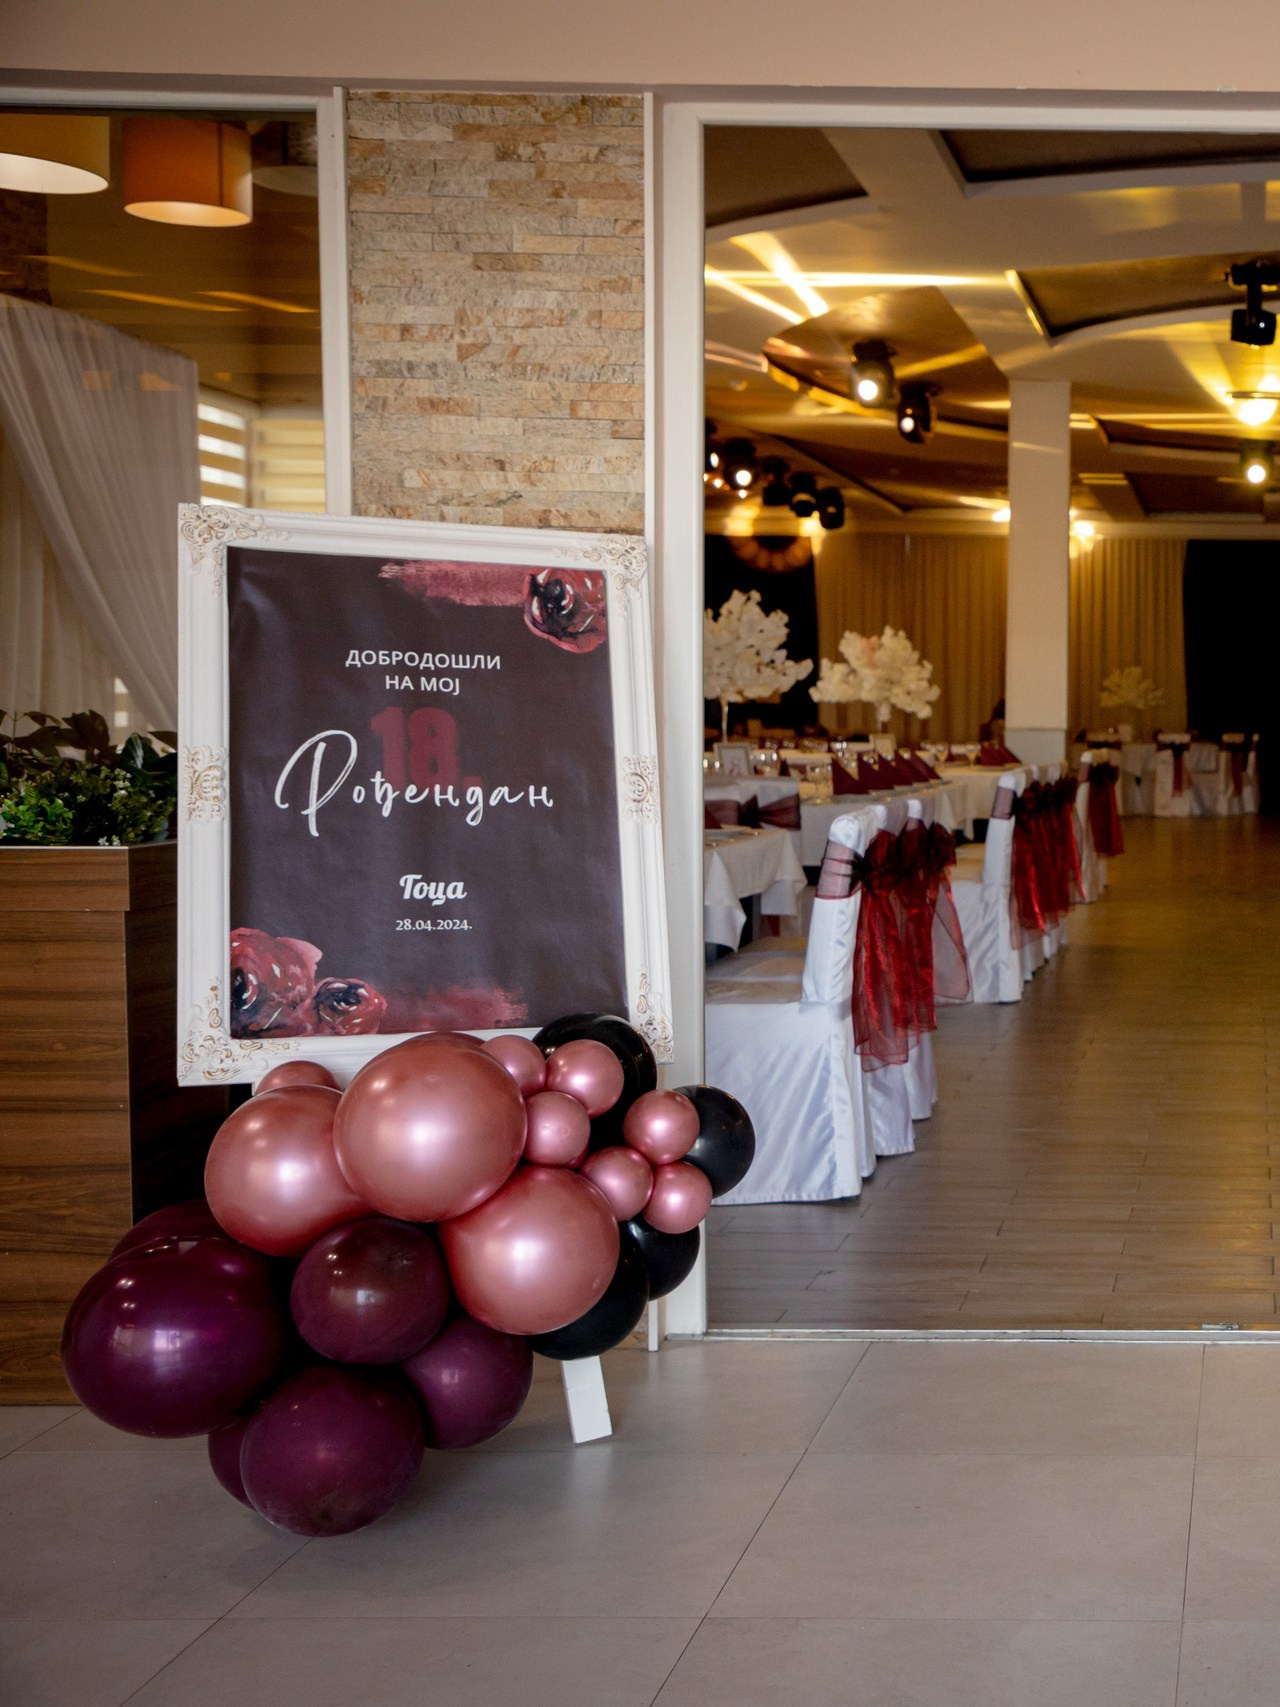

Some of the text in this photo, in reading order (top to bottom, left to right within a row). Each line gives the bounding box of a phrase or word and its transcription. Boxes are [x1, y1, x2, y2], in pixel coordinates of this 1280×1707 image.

[345, 650, 501, 670] ДОБРОДОШЛИ
[385, 675, 460, 695] НА МОЈ
[370, 706, 482, 790] 18.
[274, 729, 553, 837] Рођендан
[399, 874, 467, 906] Тоца
[395, 918, 473, 931] 28.04.2024.
